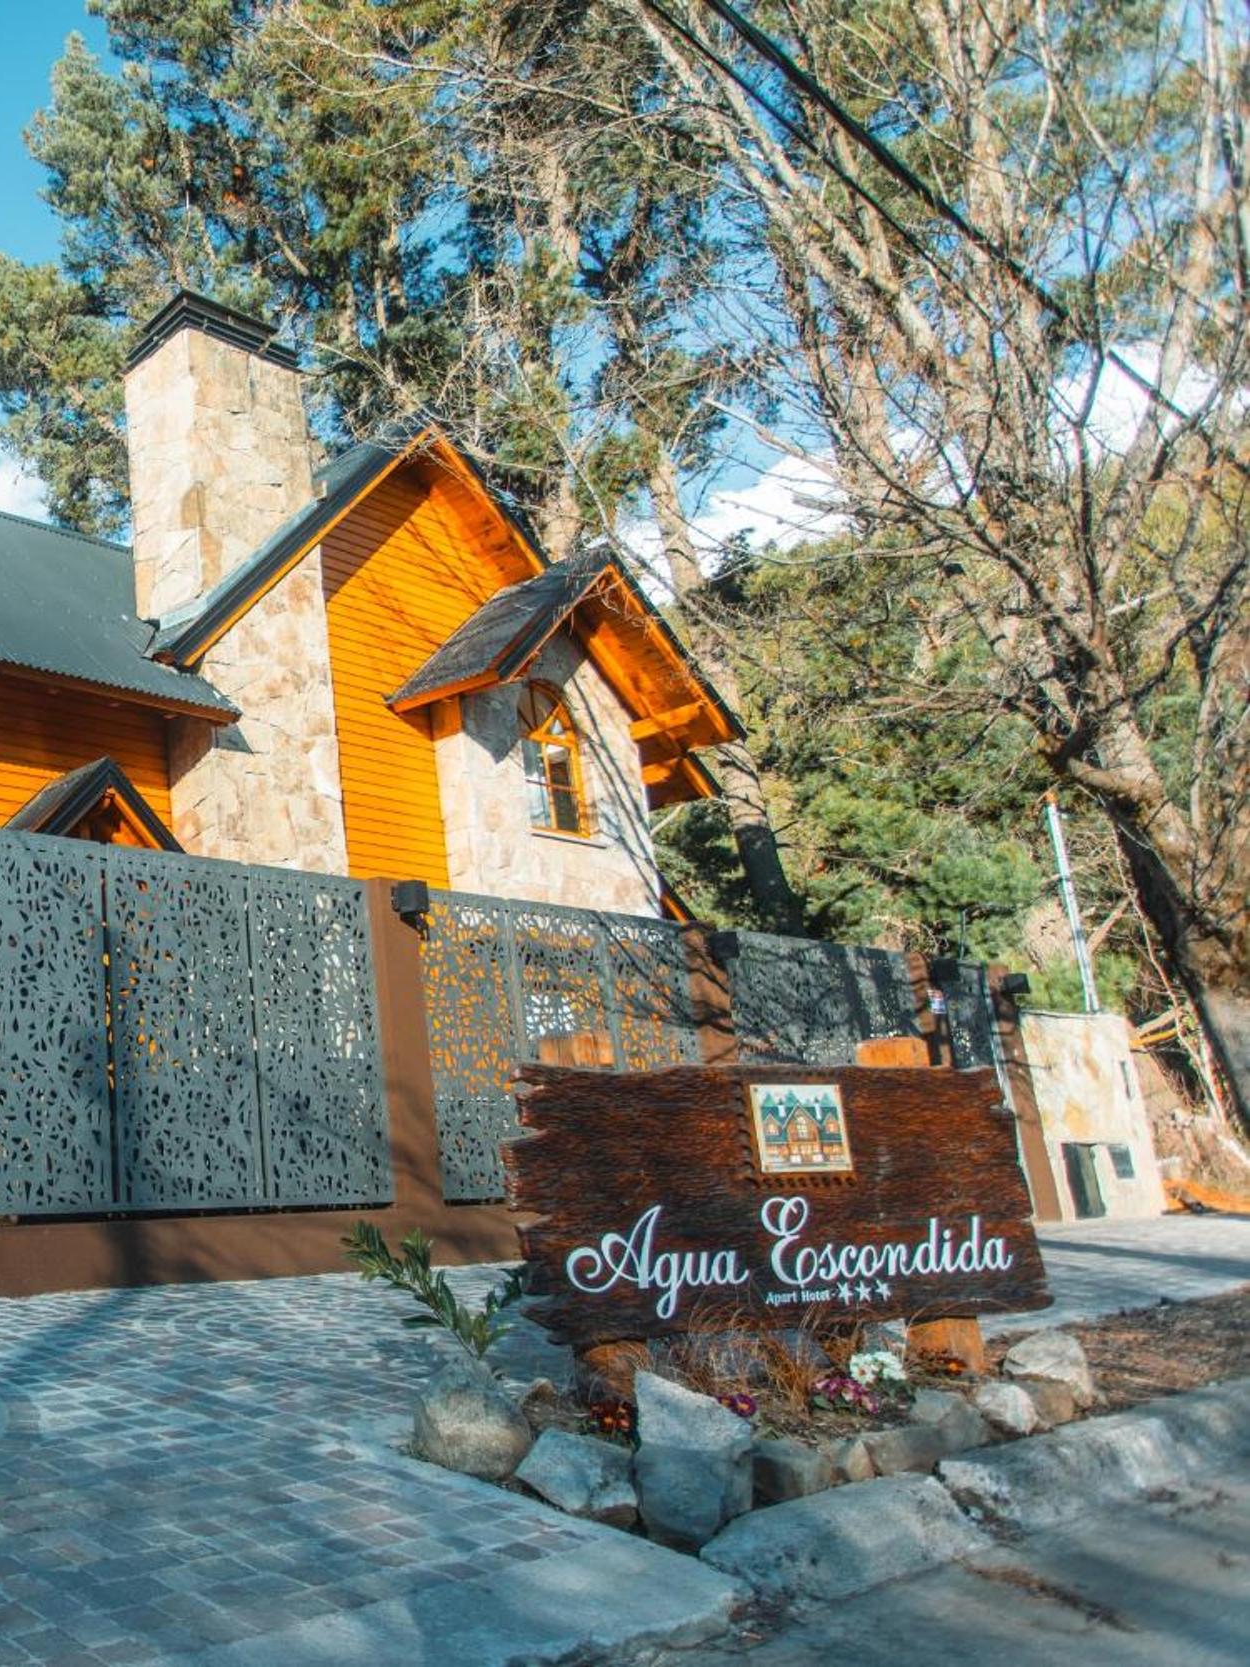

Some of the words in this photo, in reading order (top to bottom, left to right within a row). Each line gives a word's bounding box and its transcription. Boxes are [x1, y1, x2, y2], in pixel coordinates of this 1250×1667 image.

[565, 1204, 749, 1319] Agua
[760, 1195, 1014, 1288] Escondida
[765, 1291, 797, 1307] Apart
